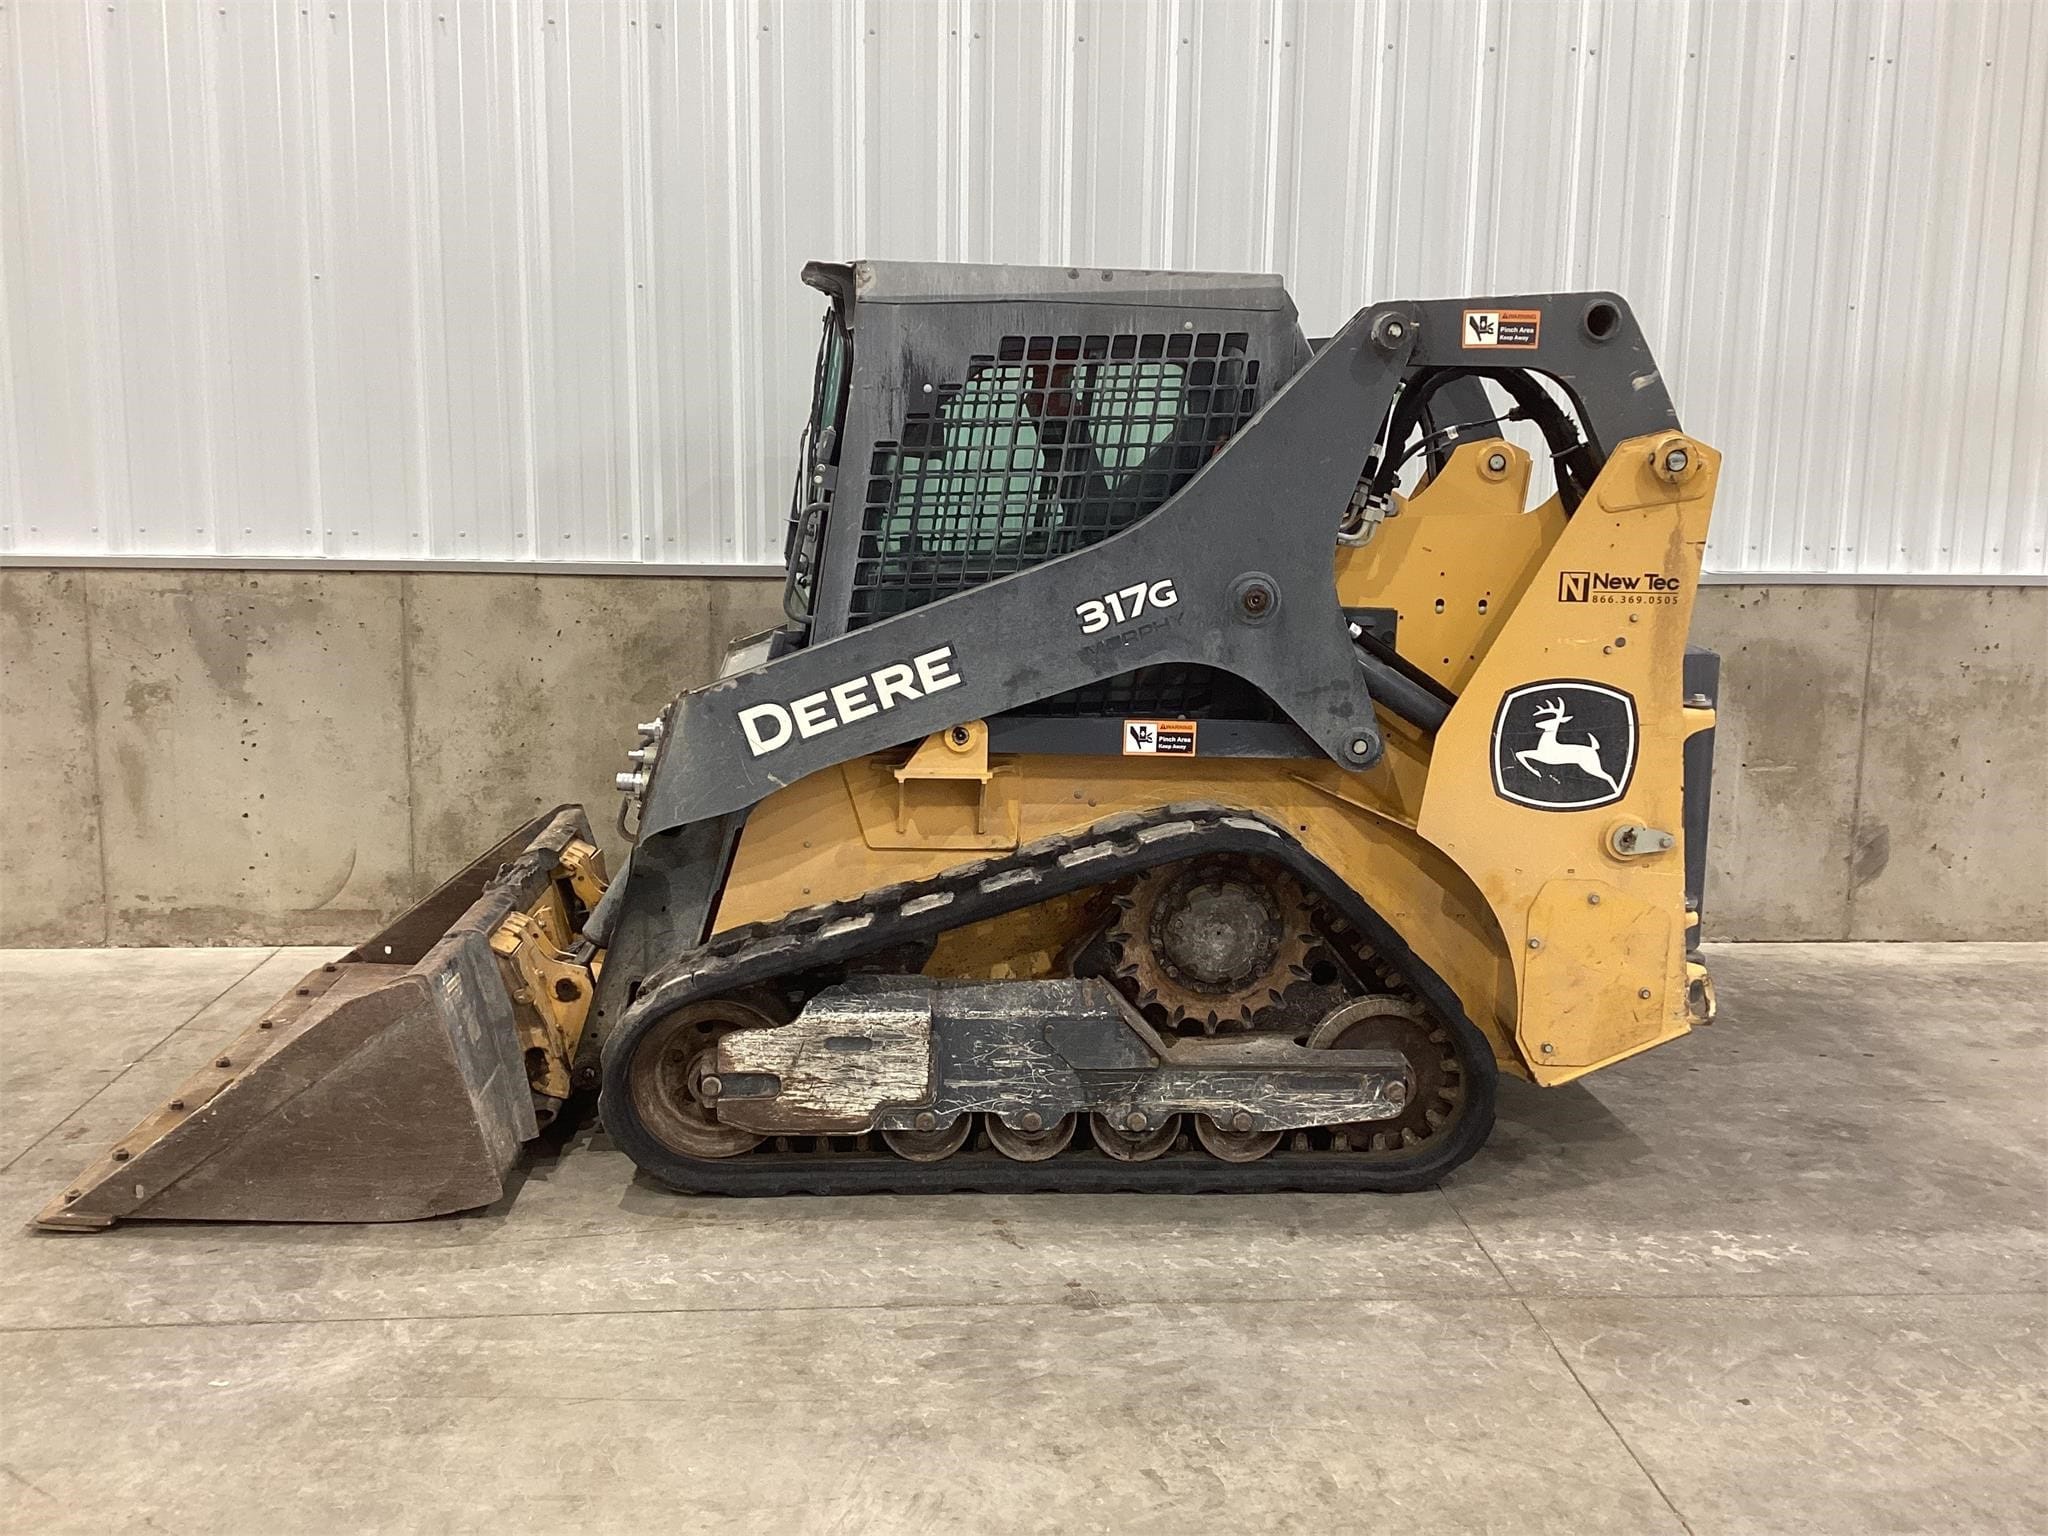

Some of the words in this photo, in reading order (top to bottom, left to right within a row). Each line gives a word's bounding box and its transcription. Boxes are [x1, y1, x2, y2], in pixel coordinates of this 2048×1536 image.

[1500, 326, 1518, 334] Pinch
[1592, 573, 1641, 590] New
[1644, 573, 1680, 591] Tec
[1075, 578, 1178, 635] 317G
[1592, 595, 1679, 605] 866.369.0505
[737, 645, 962, 758] DEERE
[1158, 735, 1176, 743] Pinch
